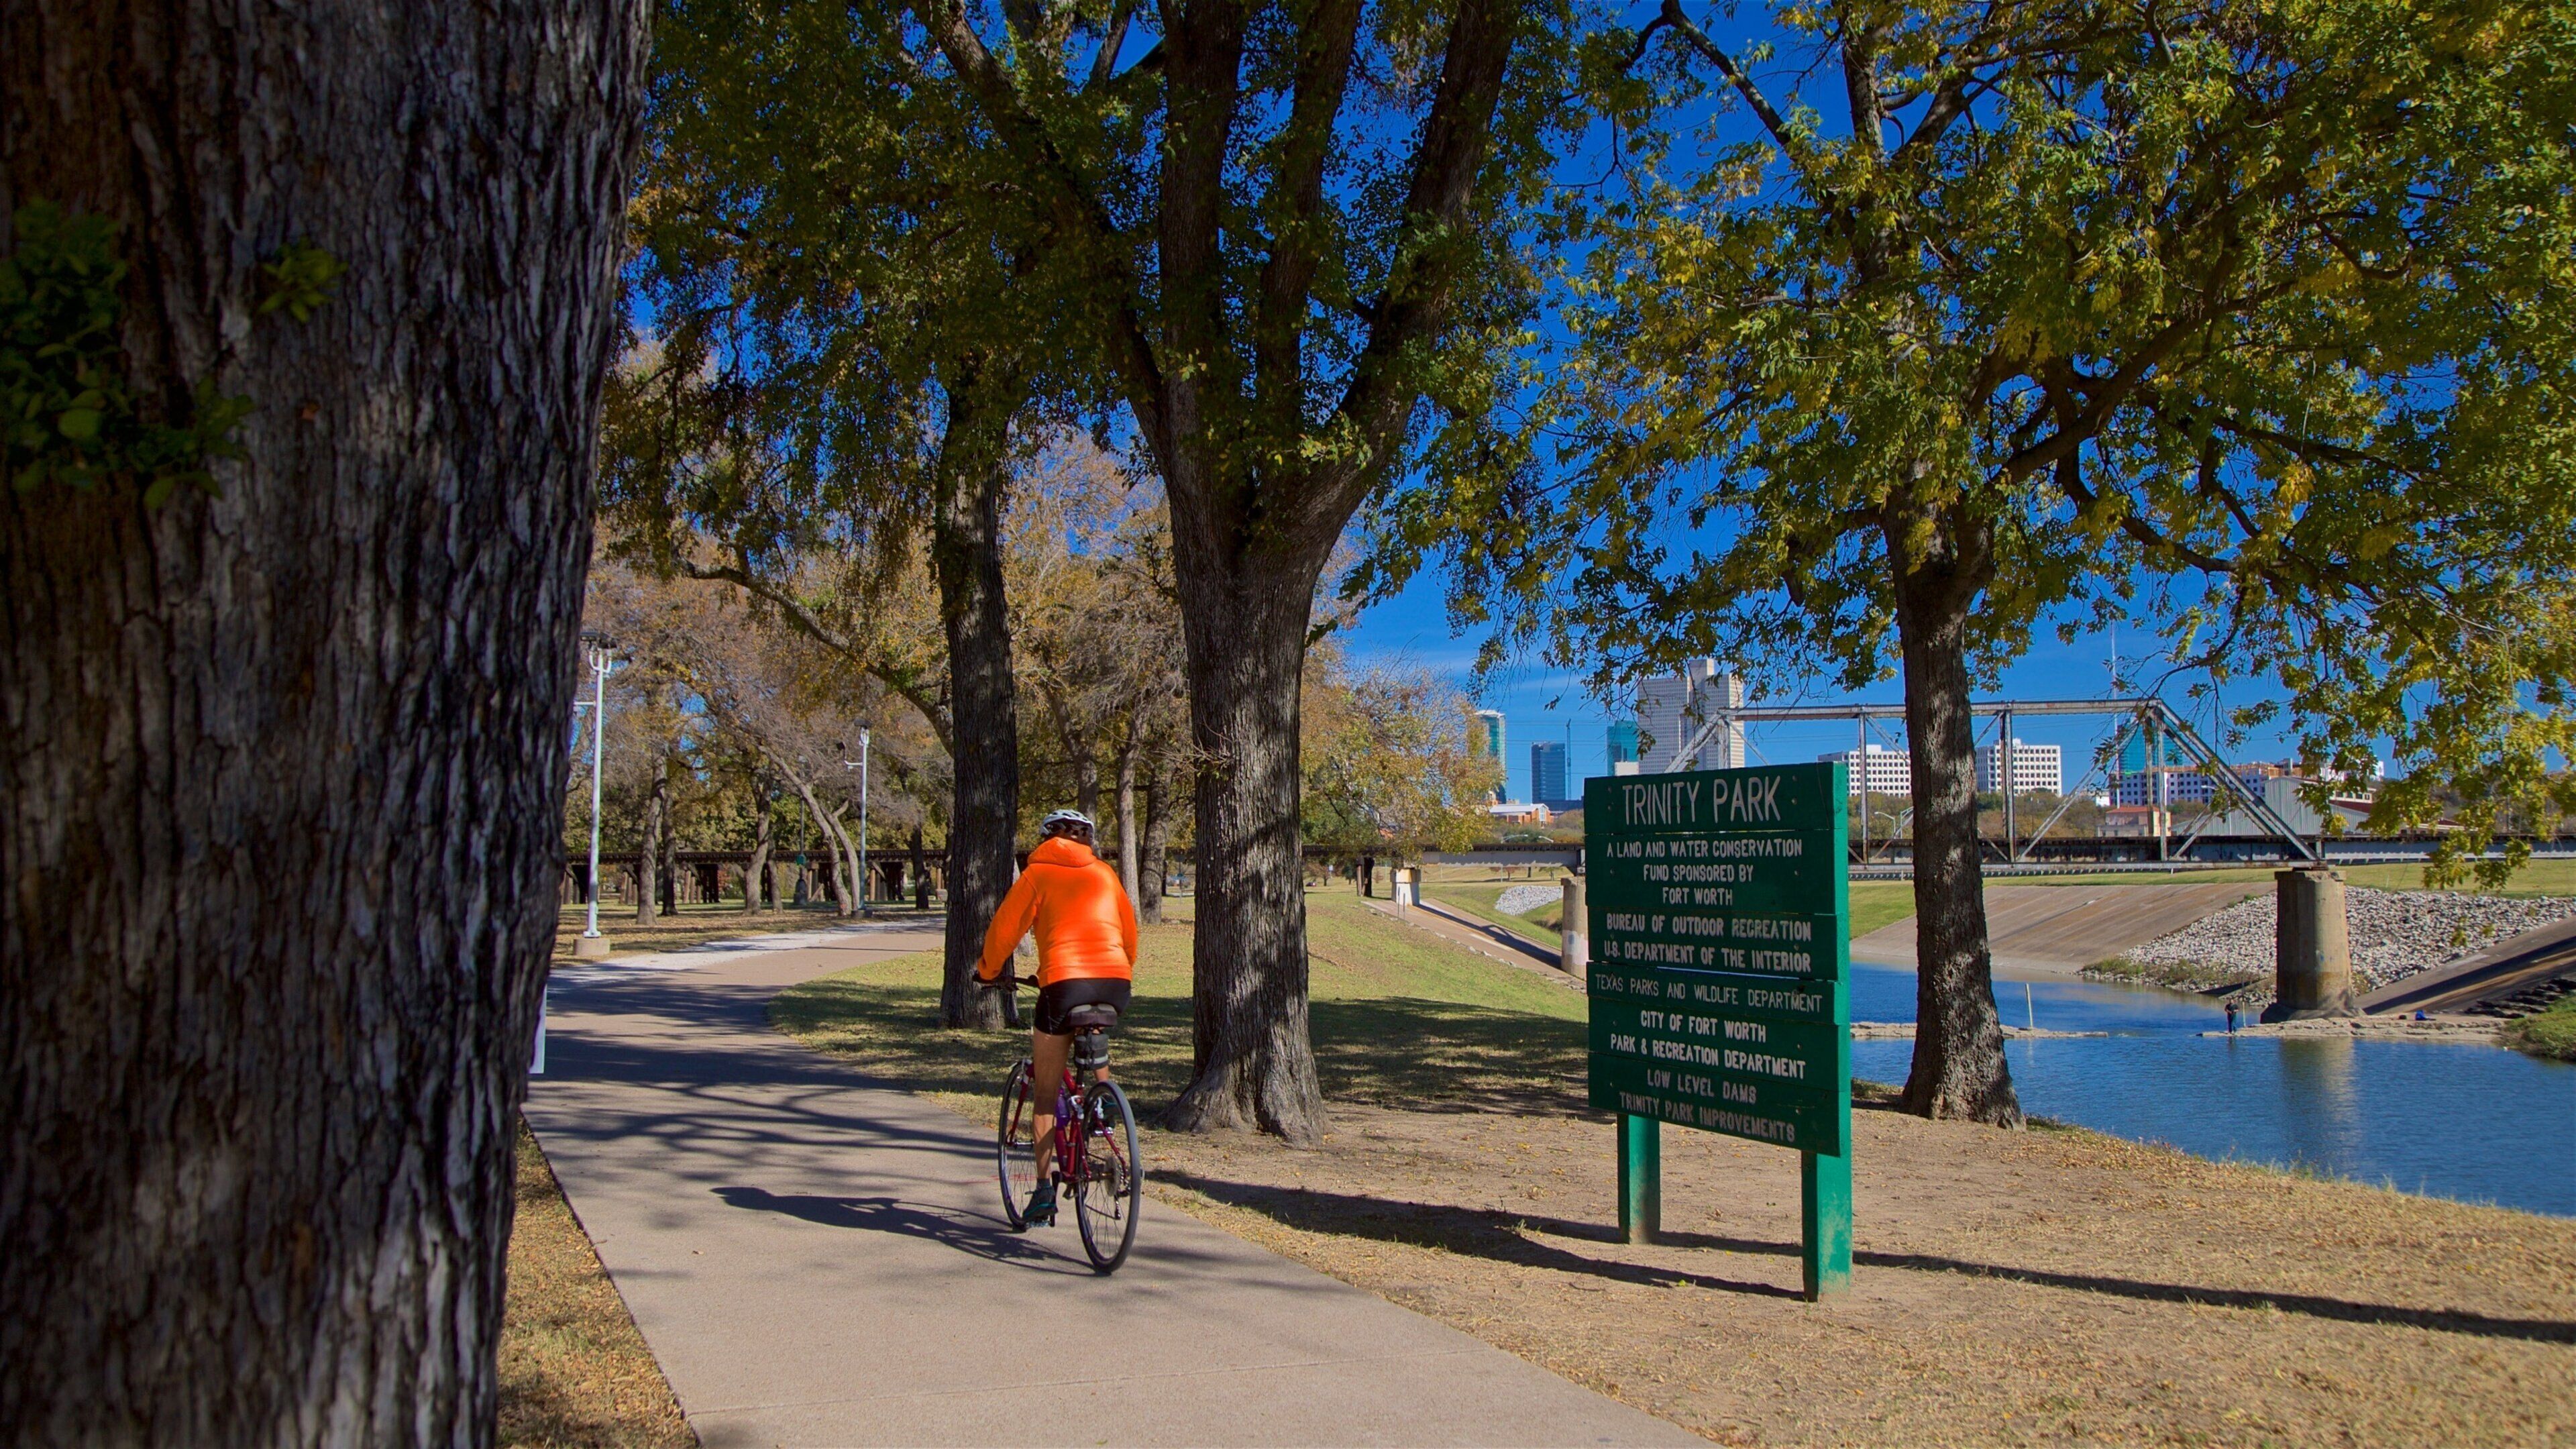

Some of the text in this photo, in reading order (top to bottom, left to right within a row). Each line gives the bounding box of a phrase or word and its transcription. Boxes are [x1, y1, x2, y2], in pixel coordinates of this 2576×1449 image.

[1623, 776, 1780, 824] TRINITY PARK
[1607, 839, 1801, 857] A LAND AND WATER CONSERVATION
[1644, 865, 1753, 881] FUND SPONSORED BY
[1663, 888, 1732, 905] FORT WORTH
[1607, 914, 1811, 941] BUREAU OF OUTDOOR RECREATION
[1605, 941, 1811, 971] U.S. DEPARTMENT OF THE INTERIOR
[1595, 973, 1822, 1012] TEXAS PARKS AND WILDLIFE DEPARTMENT
[1642, 1010, 1766, 1042] CITY OF FORT WORTH
[1611, 1034, 1805, 1079] PARK & RECREATION DEPARTMENT
[1648, 1070, 1756, 1103] LOW LEVEL DAMS
[1619, 1091, 1794, 1142] TRINITY PARK IMPROVEMENTS
